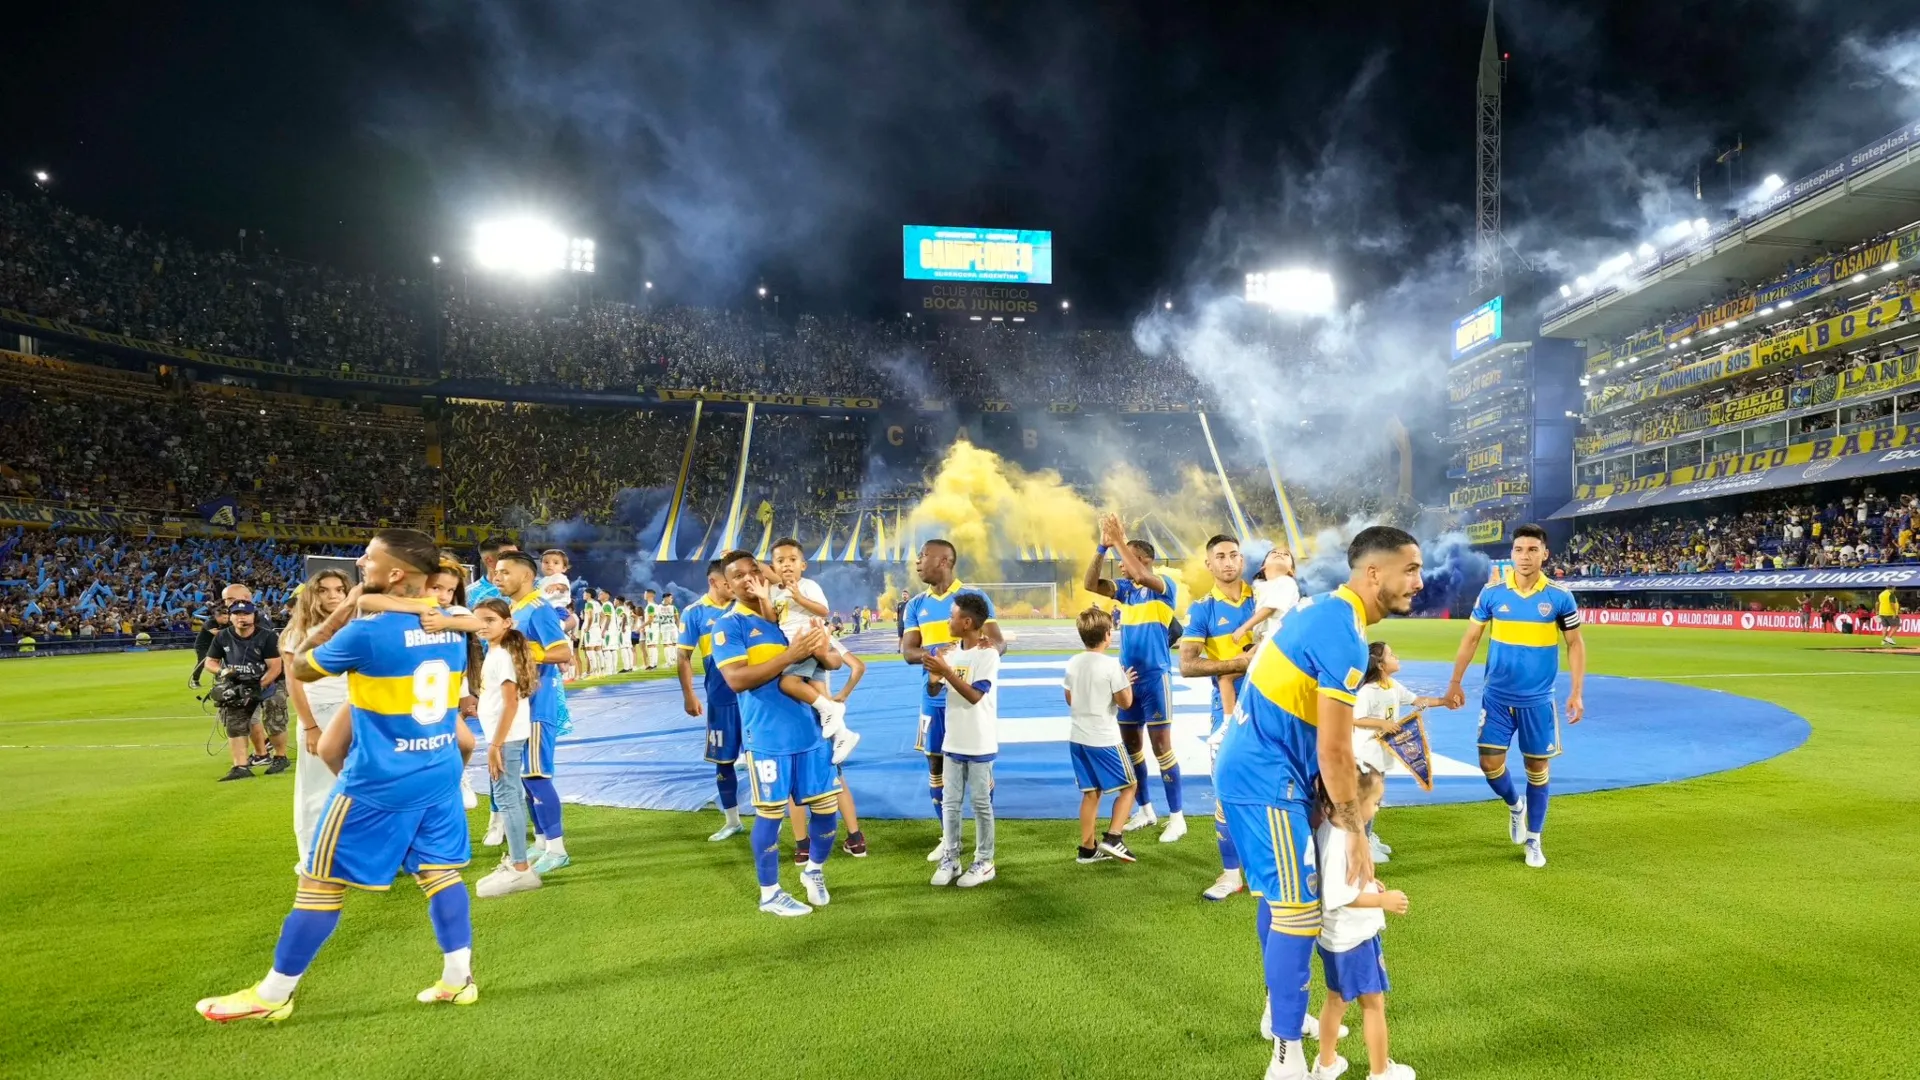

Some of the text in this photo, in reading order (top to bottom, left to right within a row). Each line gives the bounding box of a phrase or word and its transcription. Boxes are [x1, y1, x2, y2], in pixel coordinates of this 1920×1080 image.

[1851, 131, 1909, 167] Sinteplast
[1794, 163, 1845, 195] Sinteplast
[1700, 217, 1741, 241] Sinteplast
[1664, 237, 1699, 260] Sinteplast
[932, 285, 1030, 299] CLUB ATLÉTICO
[923, 297, 1038, 313] BOCA JUNIORS
[1759, 329, 1804, 349] LOS UNICOS
[1761, 345, 1803, 366] BOCA
[1660, 350, 1751, 390] MOVIMIENTO 805
[665, 391, 875, 408] LA NUMERO
[1725, 387, 1785, 412] CHELO
[1733, 401, 1786, 422] SIEMPRE
[1612, 472, 1673, 496] BOCA
[1692, 447, 1789, 483] UNICO
[1630, 577, 1673, 588] CLUB
[1672, 573, 1750, 588] ATLÉTICO
[1748, 574, 1805, 589] BOCA
[1804, 569, 1917, 585] JUNIORS
[1610, 612, 1657, 623] NALDO.COM.AR
[1677, 613, 1733, 626] NALDO.COM.AR
[411, 658, 451, 726] 9
[394, 732, 456, 752] DIRECTV
[709, 729, 723, 747] 41
